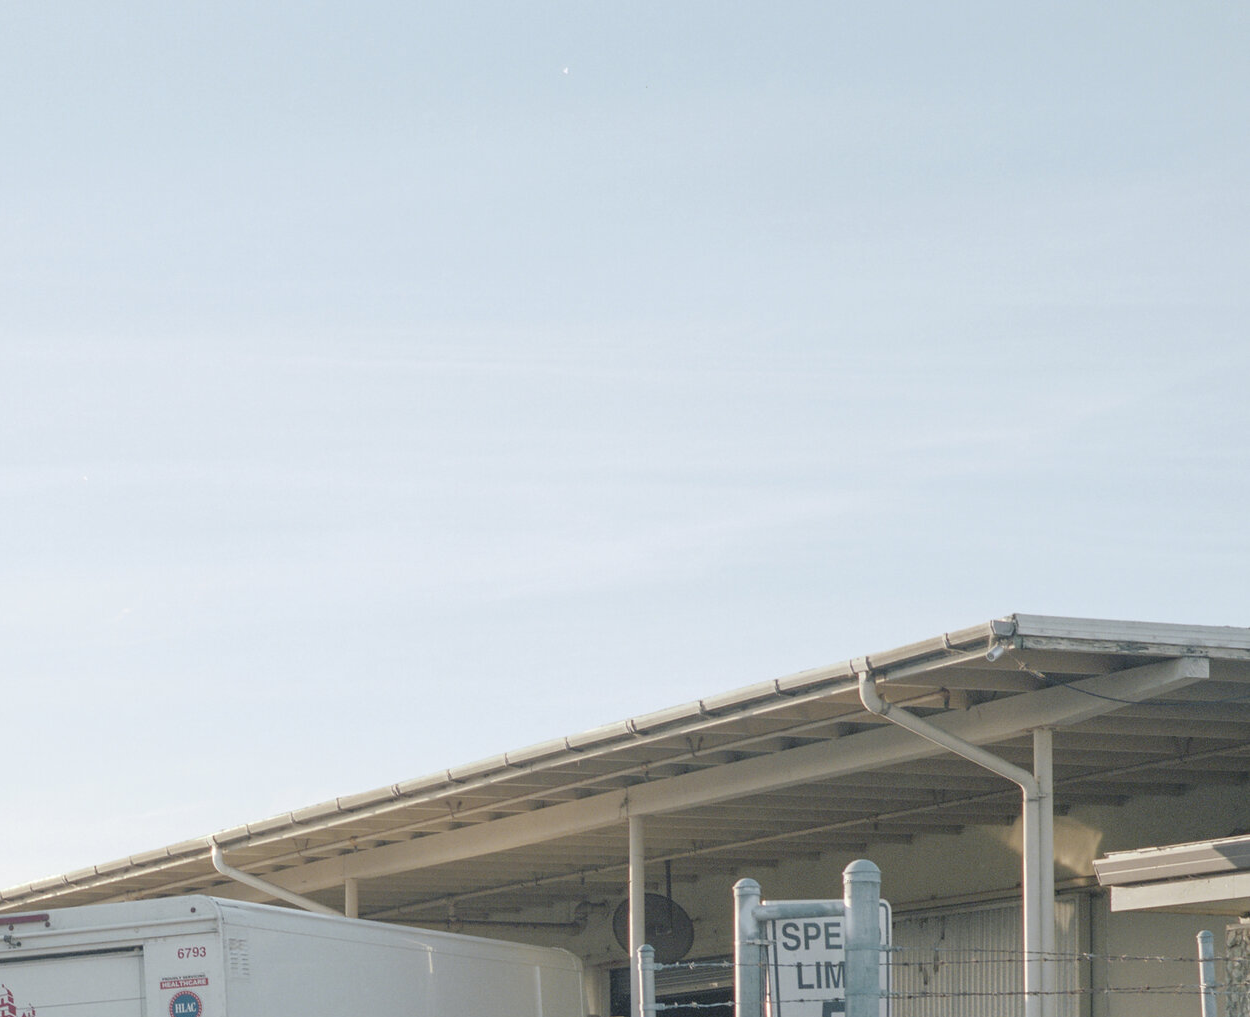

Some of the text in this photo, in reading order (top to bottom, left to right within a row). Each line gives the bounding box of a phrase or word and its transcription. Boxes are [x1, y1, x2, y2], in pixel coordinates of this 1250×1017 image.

[177, 946, 207, 959] 6793
[161, 978, 207, 988] HEALTHCARE
[175, 1002, 197, 1014] HLAC
